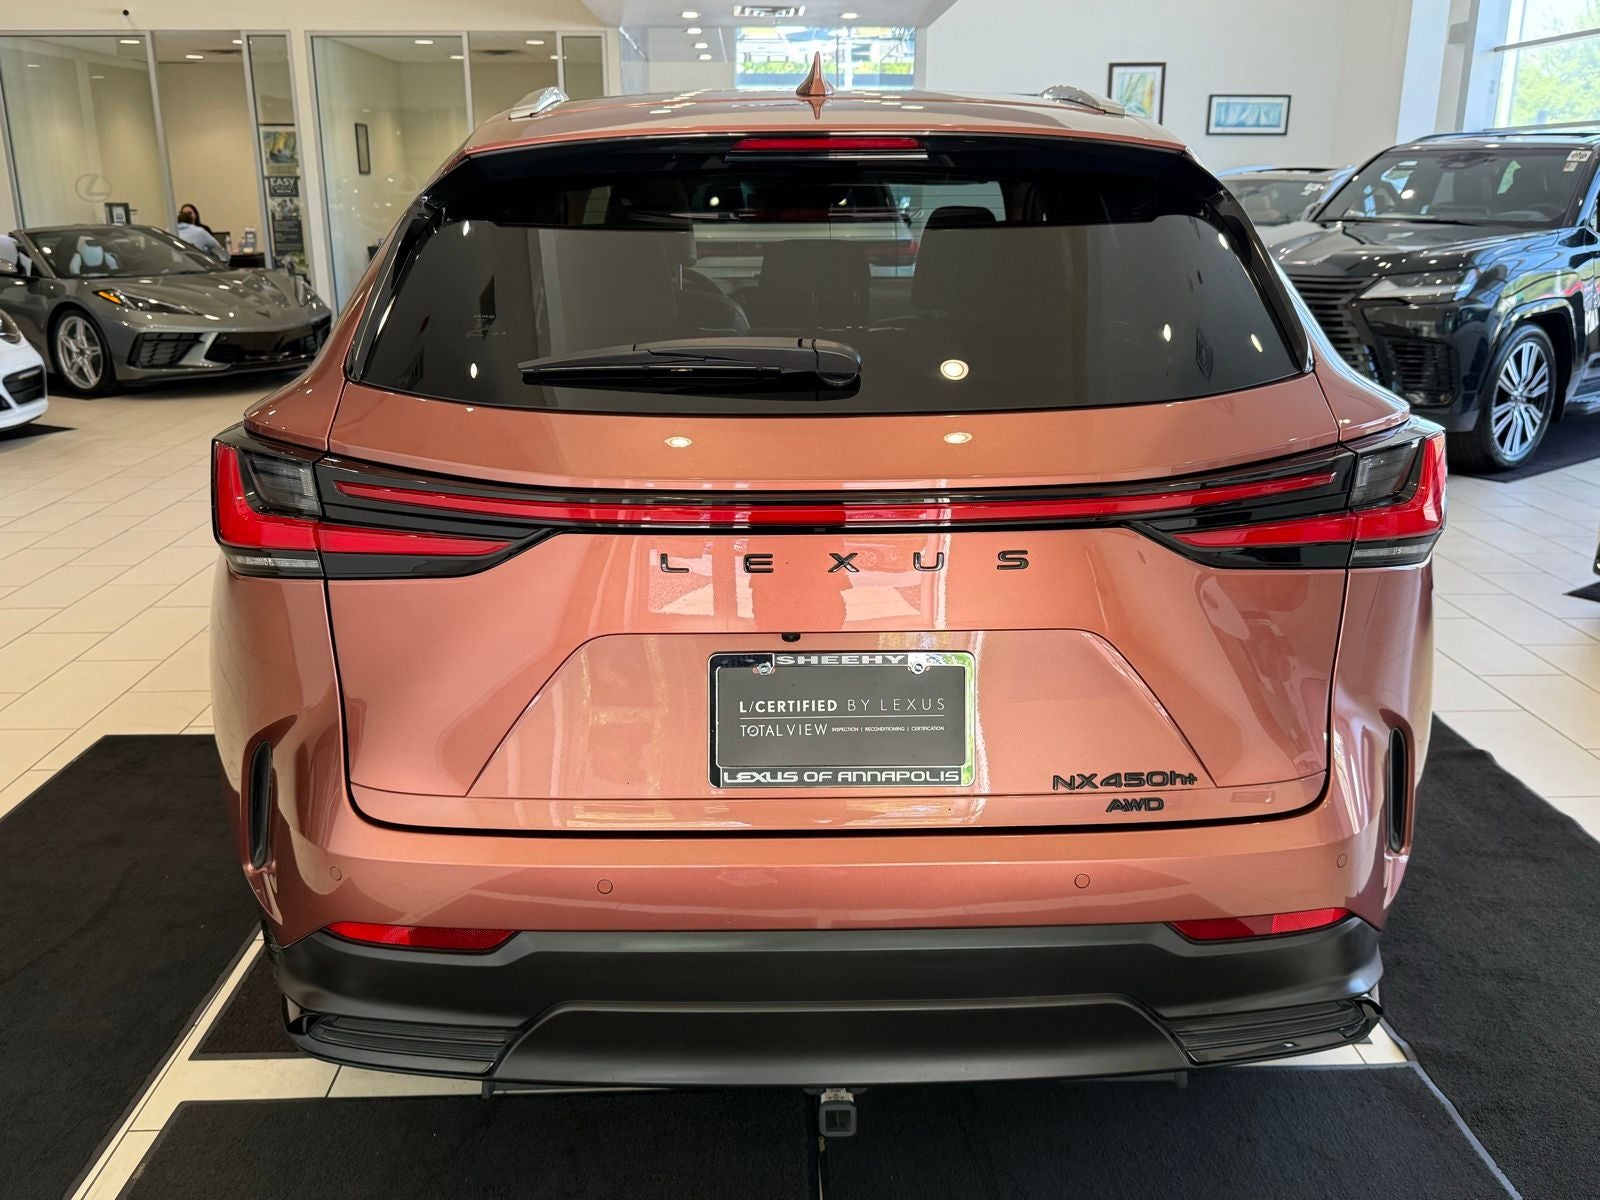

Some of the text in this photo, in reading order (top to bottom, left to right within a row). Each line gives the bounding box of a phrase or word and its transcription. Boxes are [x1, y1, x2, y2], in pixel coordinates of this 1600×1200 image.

[660, 550, 1029, 573] LEXUS
[776, 655, 906, 665] SHEEHY
[739, 698, 945, 713] L/CERTIFIED BY LEXUS
[740, 724, 784, 737] TOTAL
[786, 723, 828, 736] VIEW
[723, 770, 960, 784] LEXUS OF ANNAPOLIS
[1105, 797, 1165, 813] AWD
